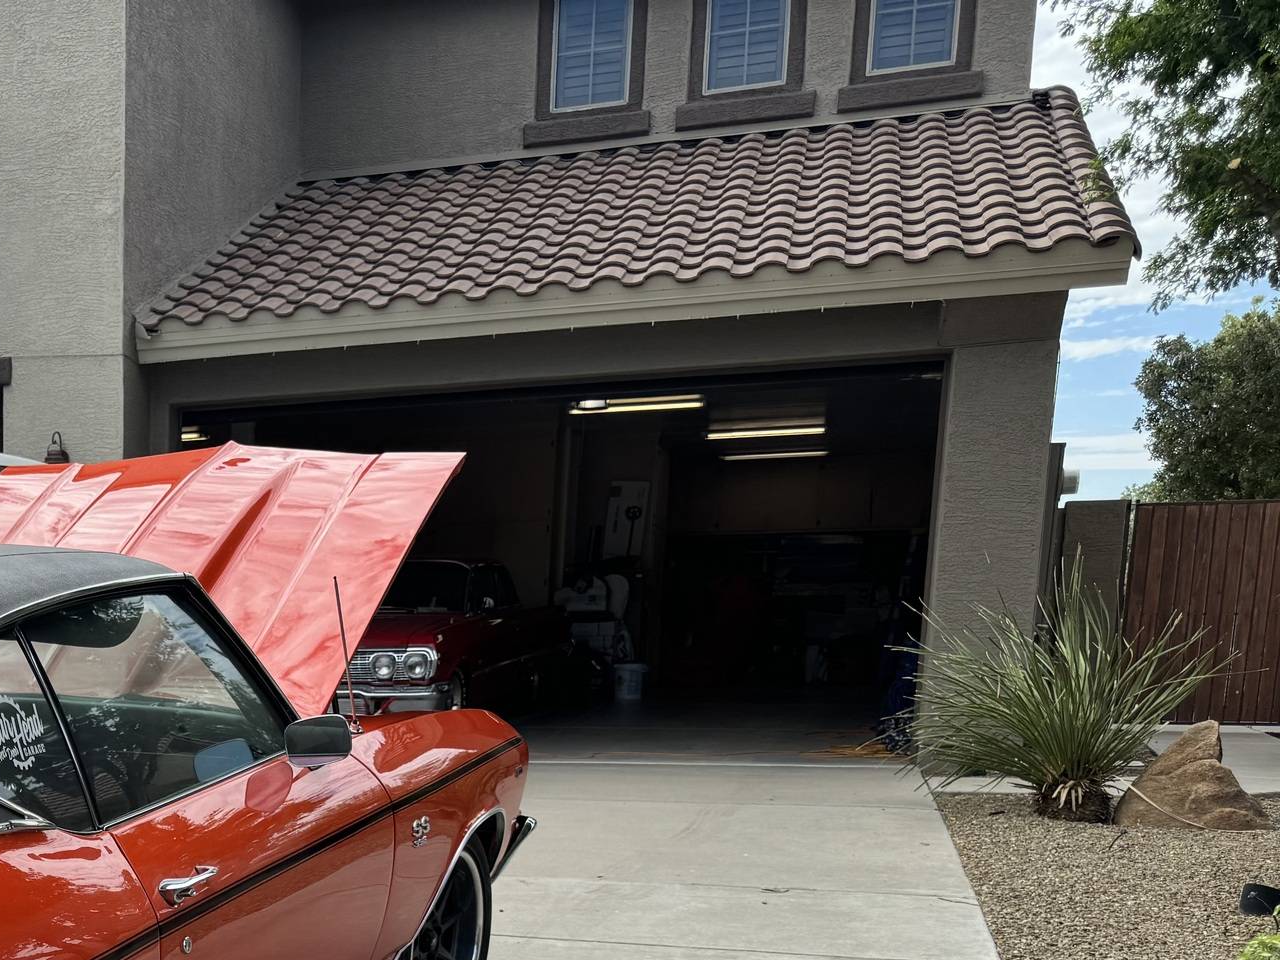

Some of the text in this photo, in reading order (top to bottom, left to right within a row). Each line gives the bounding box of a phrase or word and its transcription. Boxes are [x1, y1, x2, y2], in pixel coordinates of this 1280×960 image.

[12, 703, 44, 761] Head
[23, 743, 46, 757] GARAGE
[412, 815, 431, 838] SS
